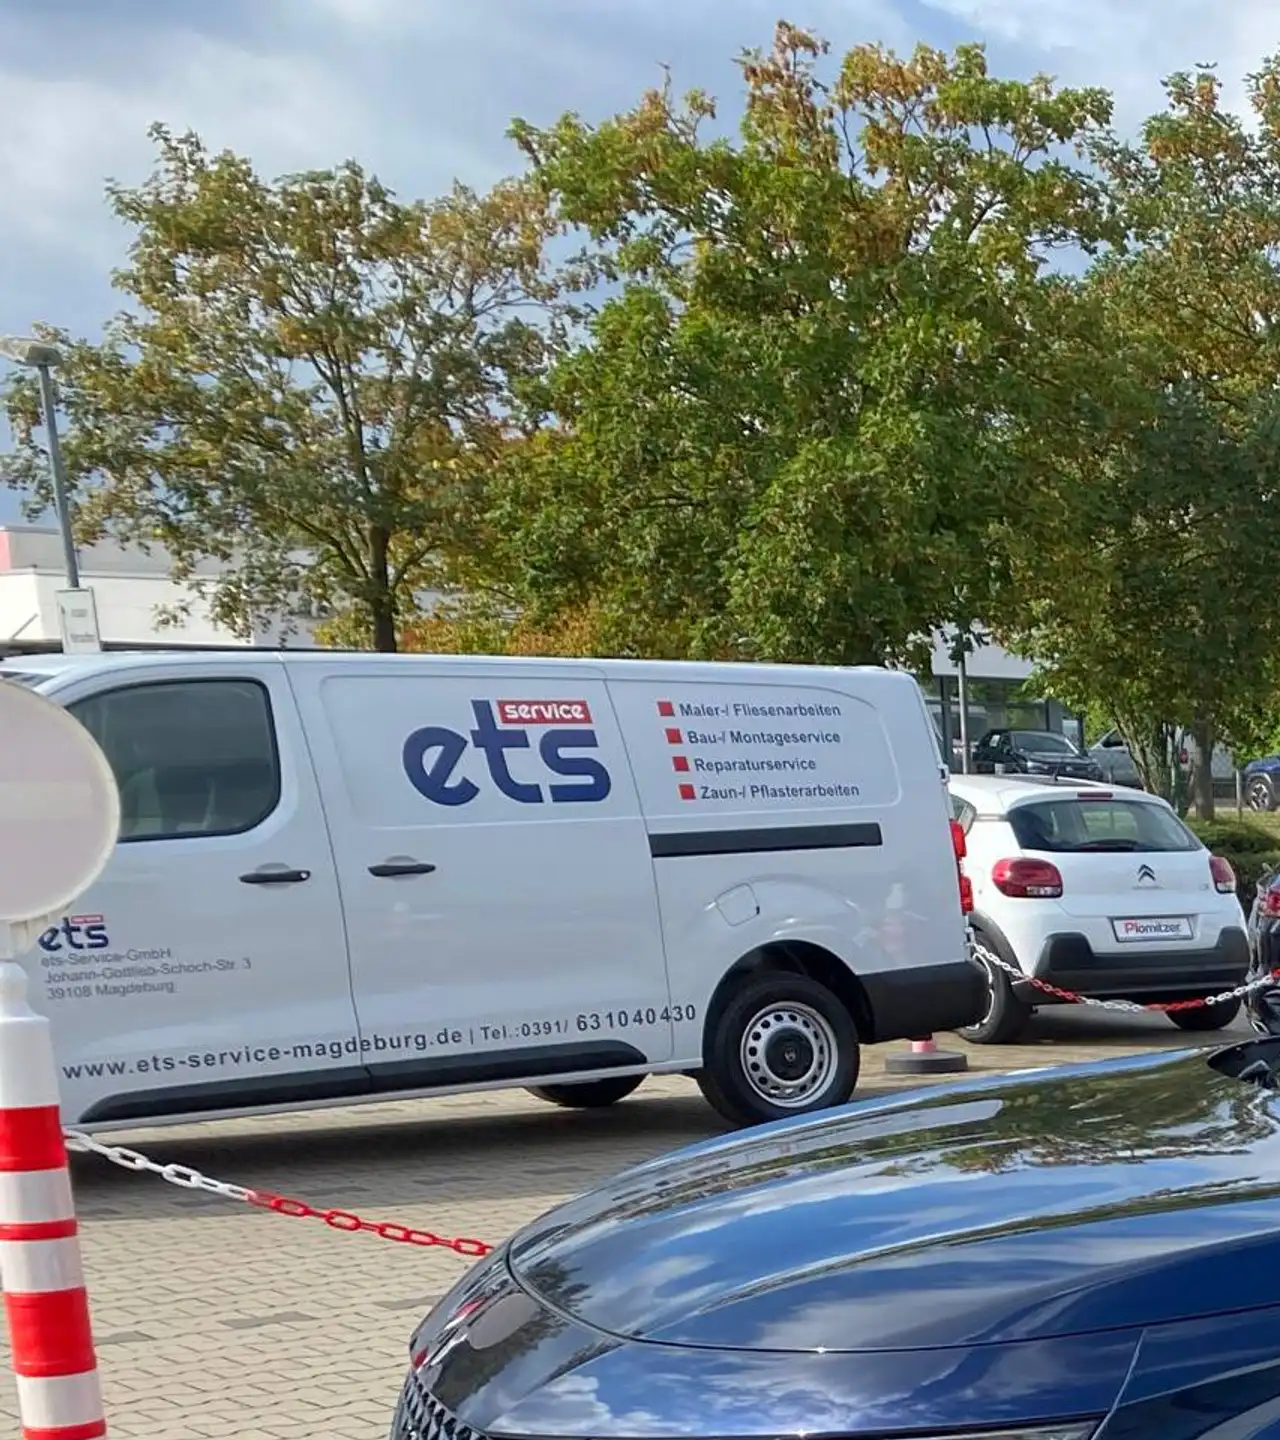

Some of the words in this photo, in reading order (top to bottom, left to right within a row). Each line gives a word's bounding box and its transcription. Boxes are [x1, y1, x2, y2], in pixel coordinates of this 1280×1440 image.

[504, 703, 585, 720] service
[733, 702, 842, 717] Fliesenarbeiten
[730, 731, 841, 747] Montageservice
[402, 698, 612, 807] ets
[694, 757, 817, 777] Reparaturservice
[750, 784, 860, 799] Pflasterarbeiten
[38, 916, 110, 952] ets
[41, 947, 172, 968] ets-Service-GmbH
[242, 957, 252, 970] 3
[47, 985, 93, 1001] 39108
[96, 980, 175, 998] Magdeburg
[62, 1027, 462, 1080] www.ets-service-magdeburg.de
